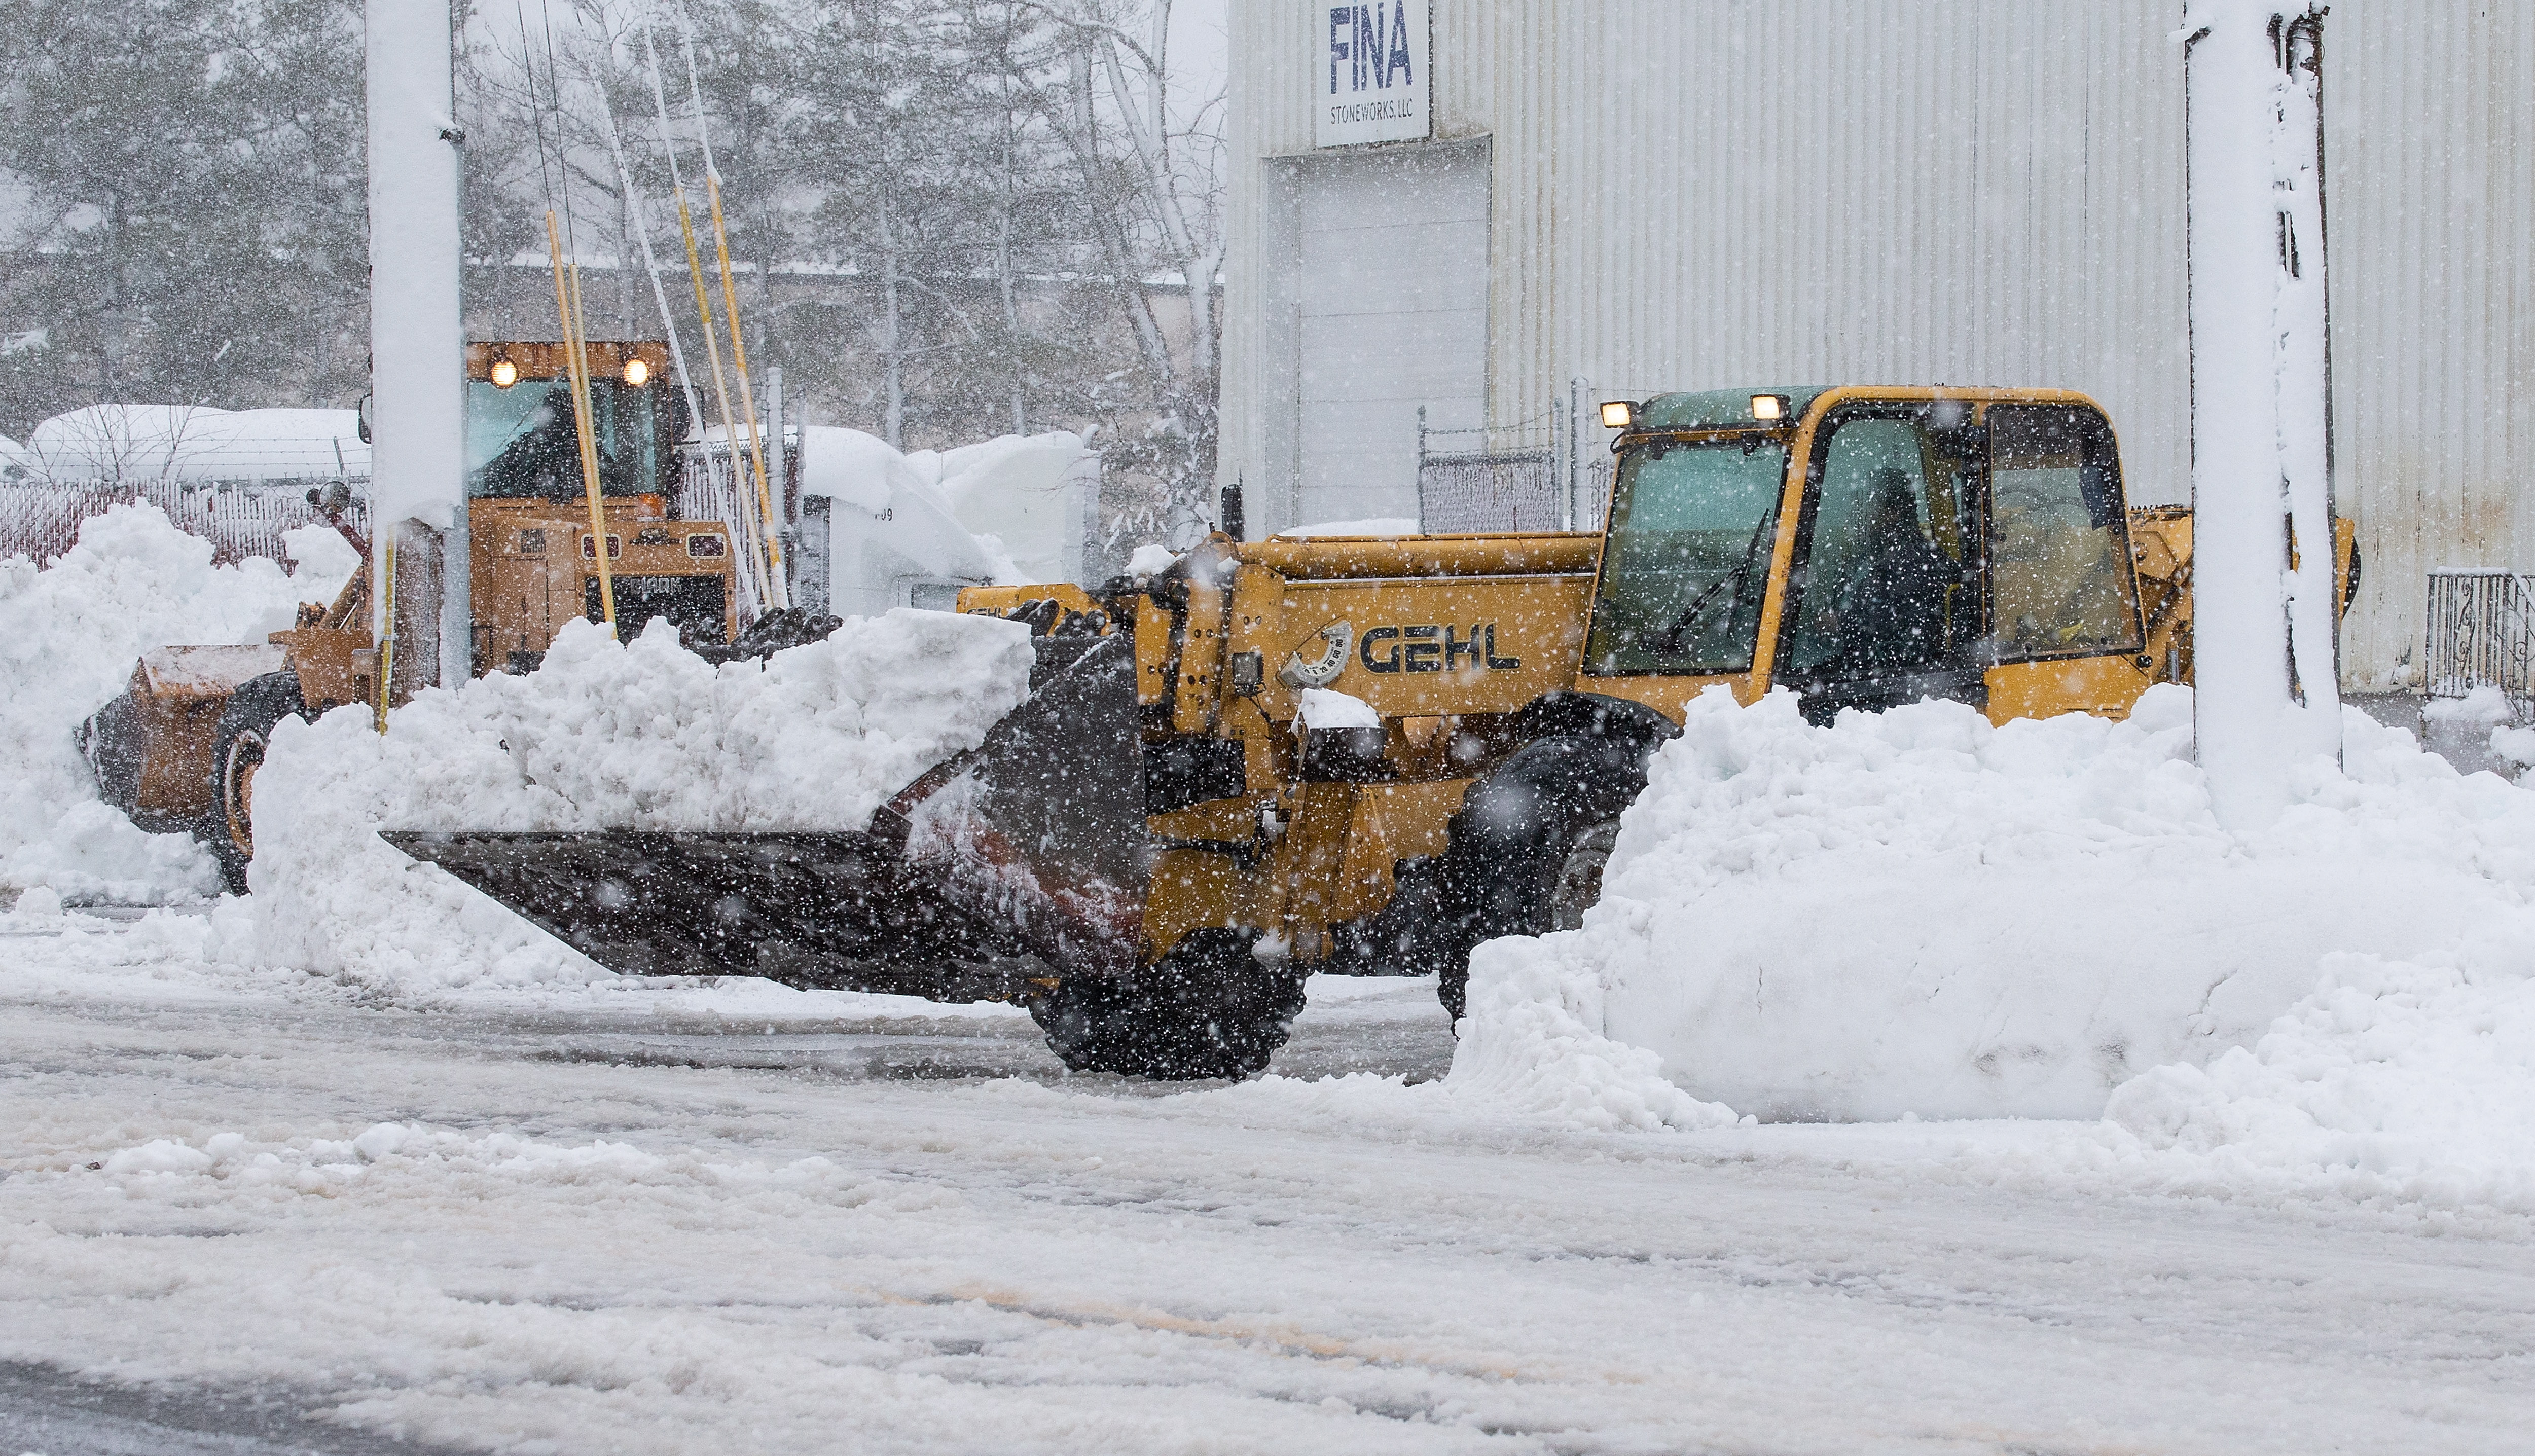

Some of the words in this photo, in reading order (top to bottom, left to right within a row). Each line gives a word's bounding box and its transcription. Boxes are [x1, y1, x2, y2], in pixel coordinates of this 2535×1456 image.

[1330, 0, 1412, 94] FINA
[1331, 100, 1396, 125] STONEWORKS,
[1398, 98, 1413, 118] LLC
[630, 576, 682, 594] CLARK
[1335, 639, 1343, 647] 80
[1360, 621, 1520, 674] GEHL
[1333, 650, 1341, 659] 60
